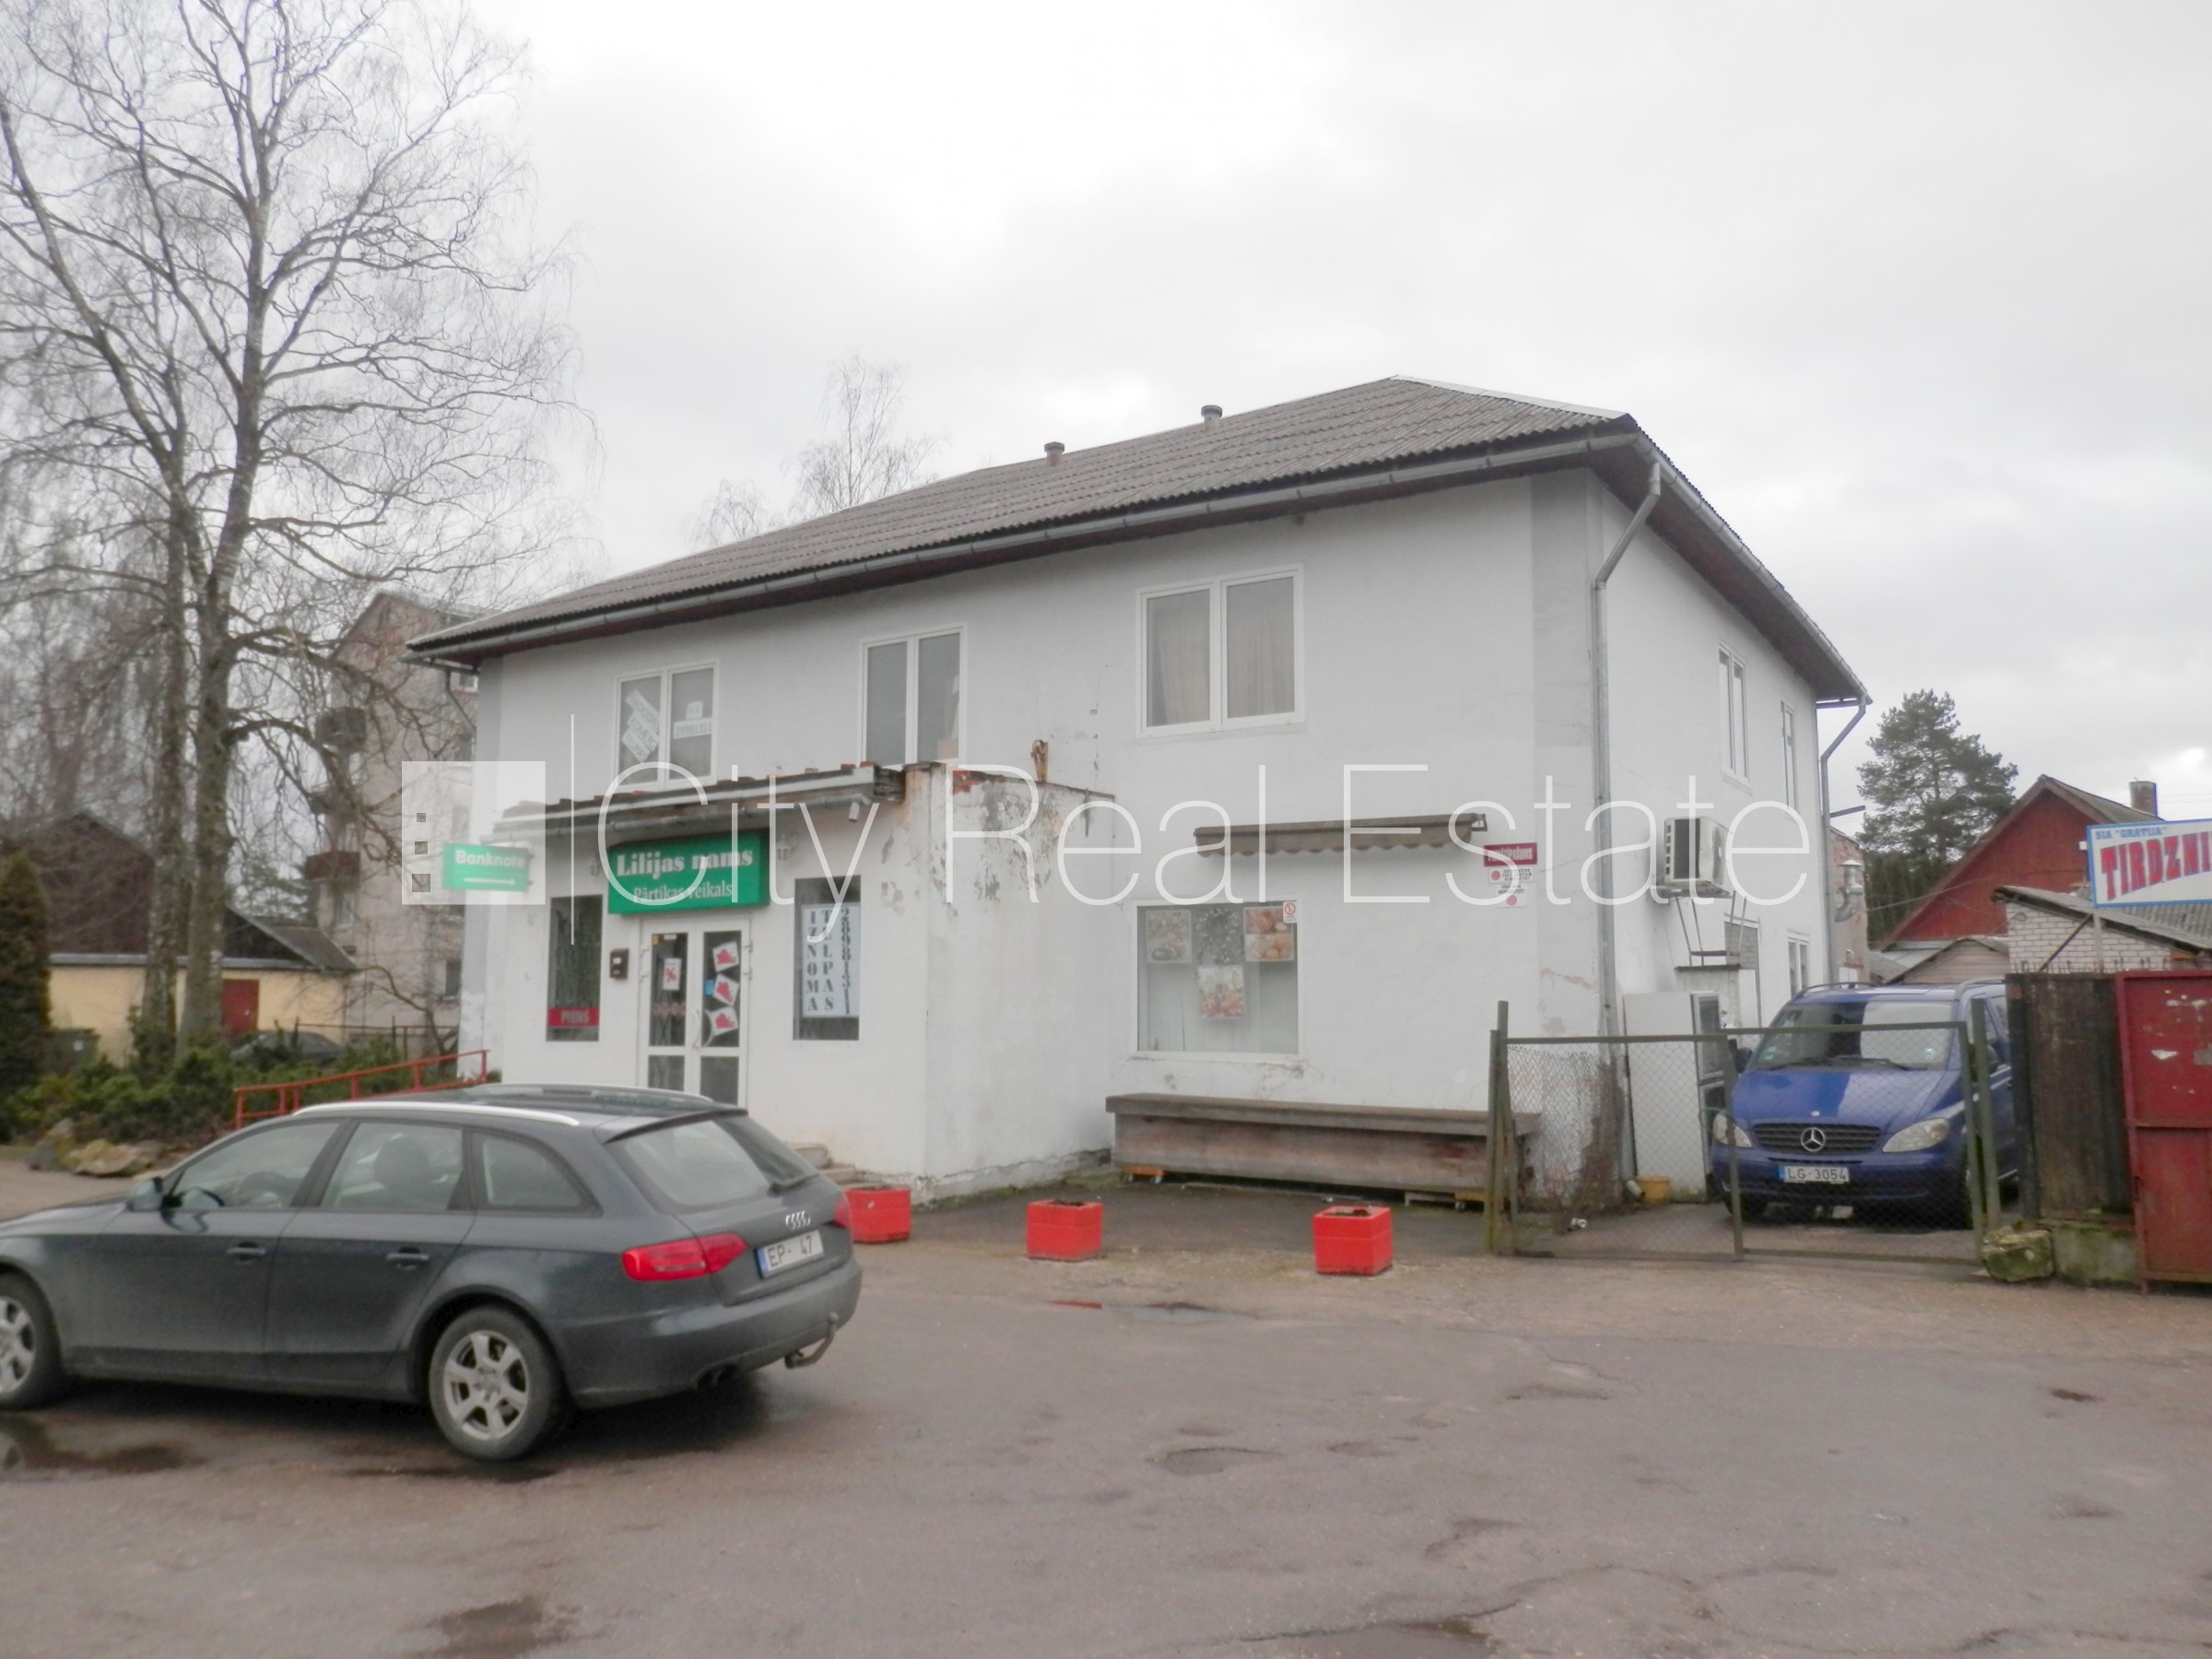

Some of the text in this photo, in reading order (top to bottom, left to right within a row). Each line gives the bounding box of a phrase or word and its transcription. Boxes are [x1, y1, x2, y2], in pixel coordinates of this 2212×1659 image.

[455, 850, 526, 868] Banknote
[617, 850, 754, 880] Lilijas nams
[633, 884, 684, 902] Pārtikas
